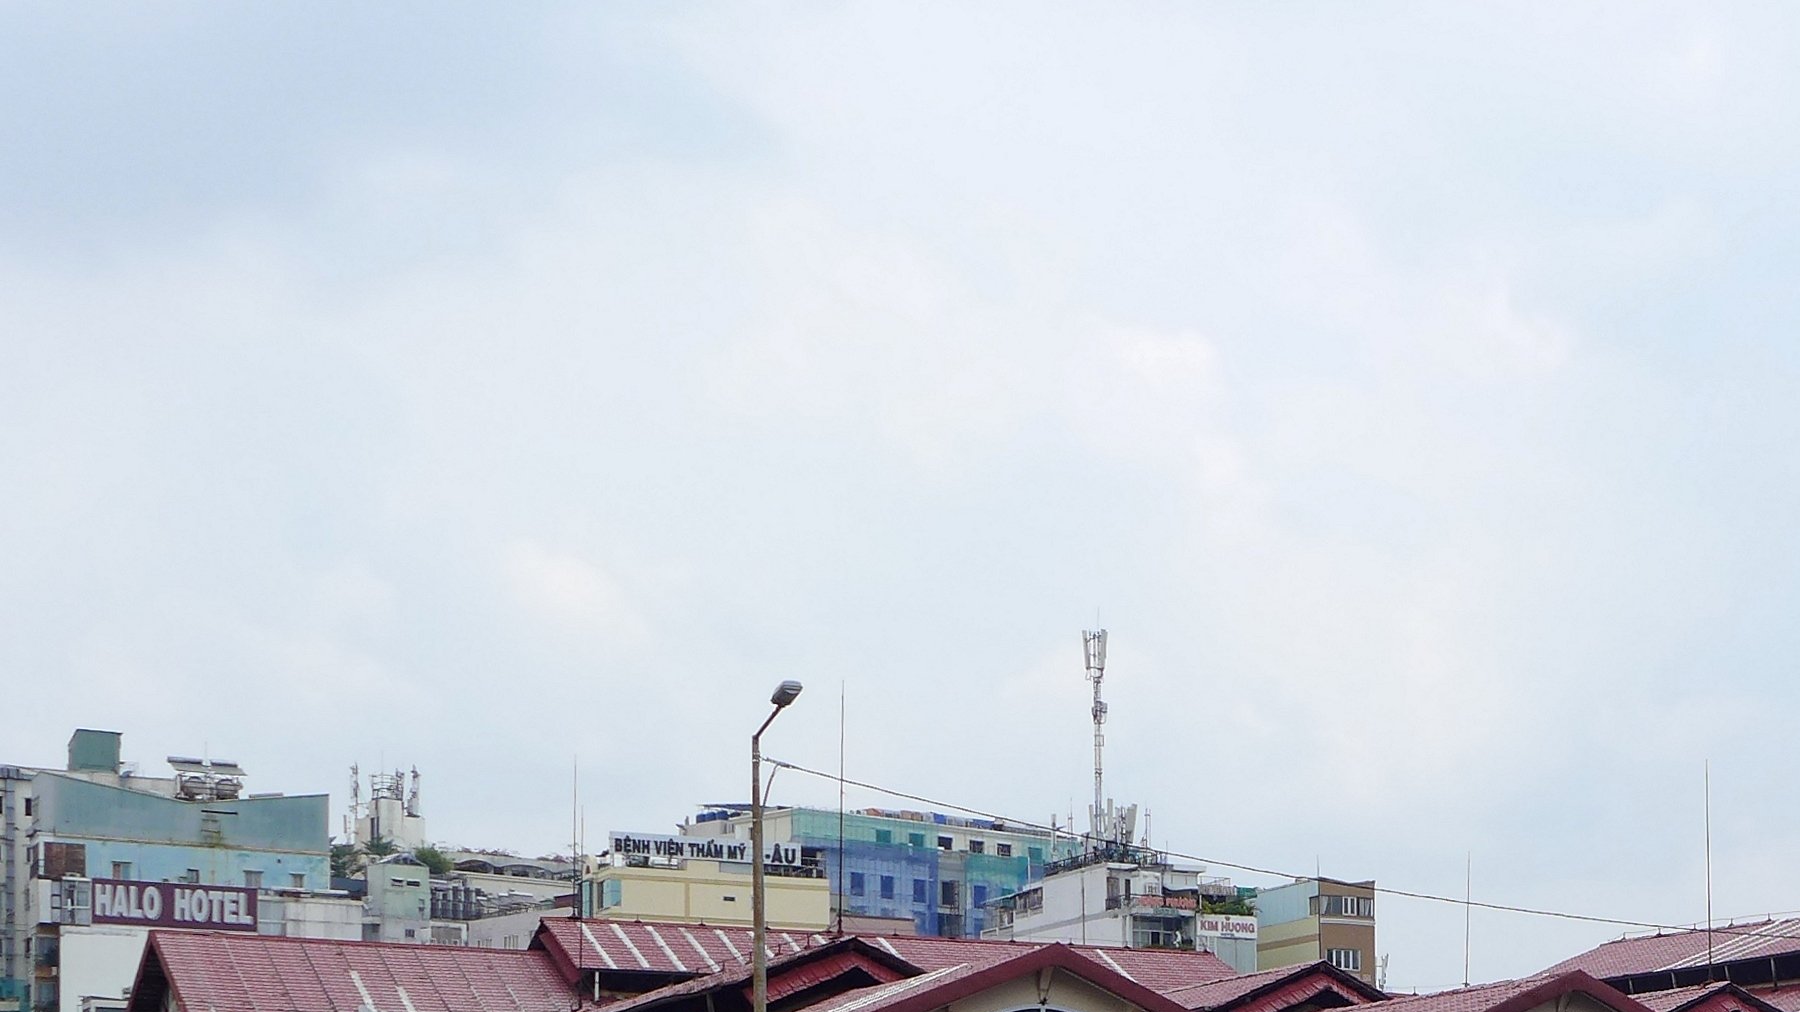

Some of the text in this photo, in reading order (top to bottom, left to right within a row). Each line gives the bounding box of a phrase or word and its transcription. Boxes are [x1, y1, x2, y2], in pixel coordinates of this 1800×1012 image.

[94, 883, 255, 926] HALO HOTEL
[1200, 920, 1219, 931] KIM
